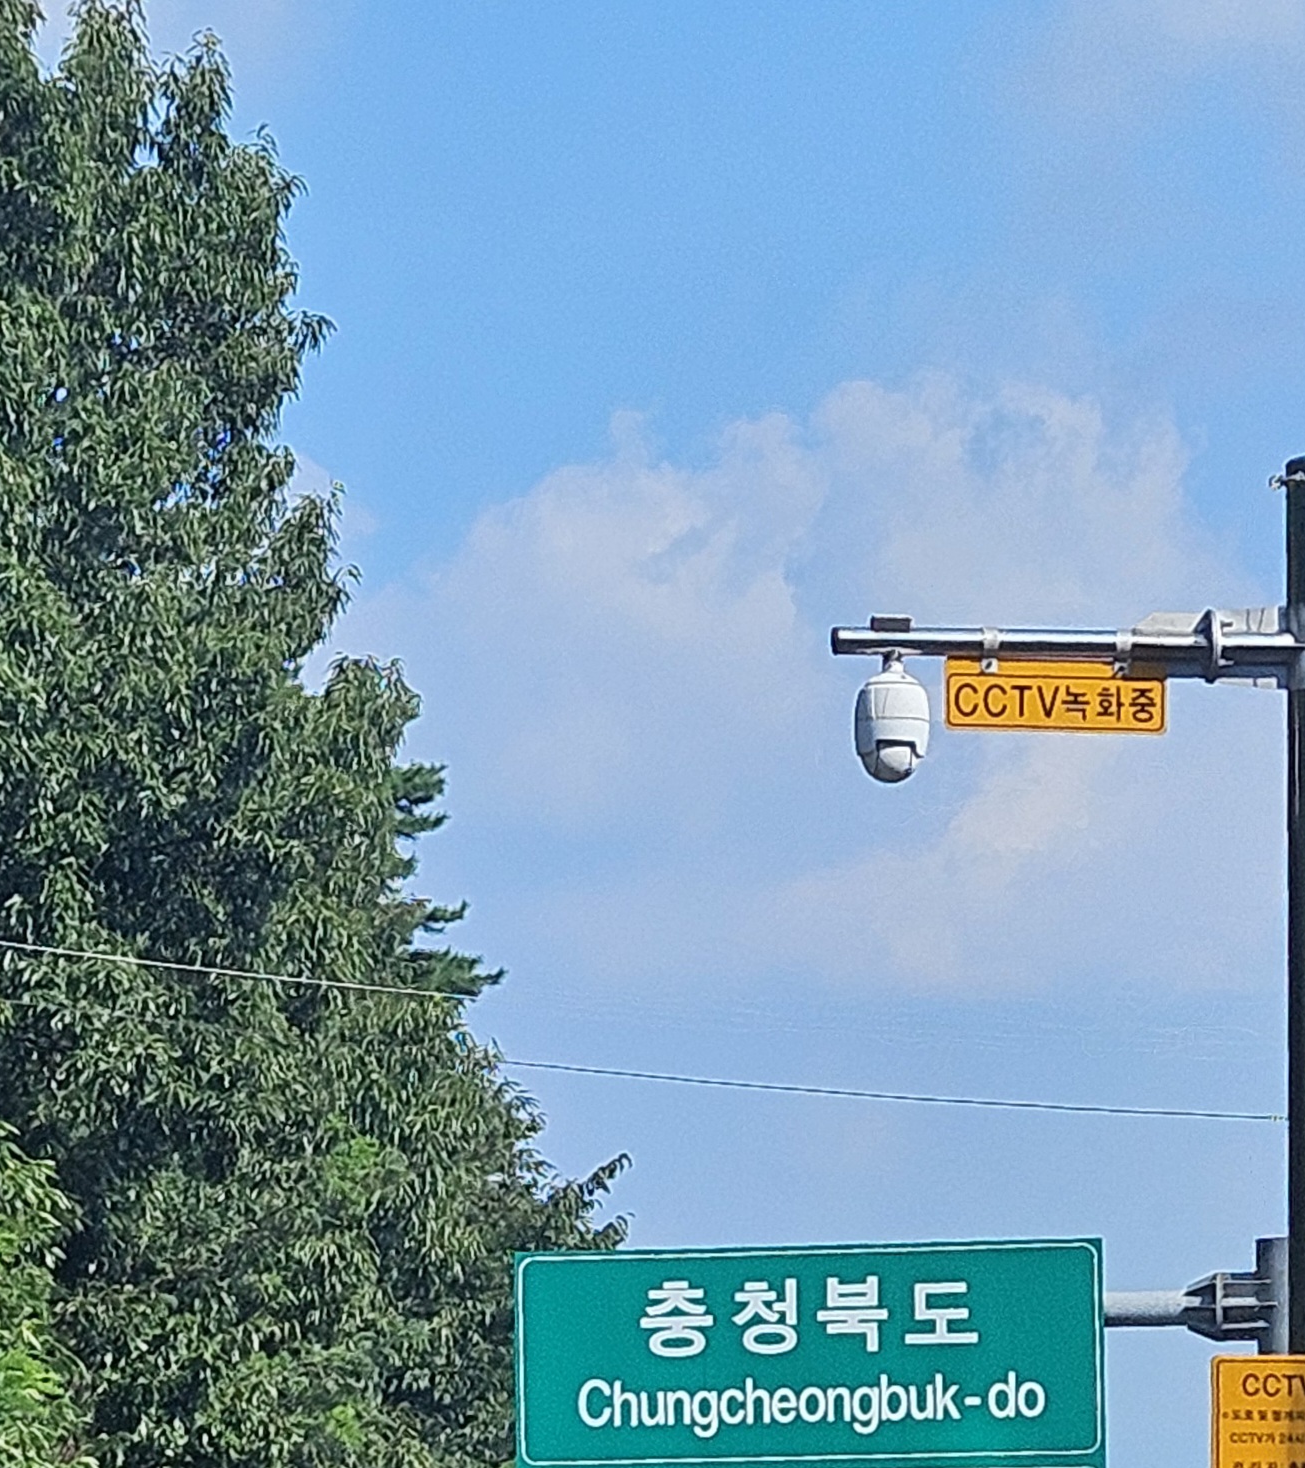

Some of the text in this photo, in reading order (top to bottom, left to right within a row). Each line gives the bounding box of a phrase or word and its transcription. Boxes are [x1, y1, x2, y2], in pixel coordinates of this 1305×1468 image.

[953, 681, 1158, 723] CCTV녹화중
[639, 1275, 980, 1357] 충청북도
[577, 1371, 1046, 1438] Chungcheongbuk-do
